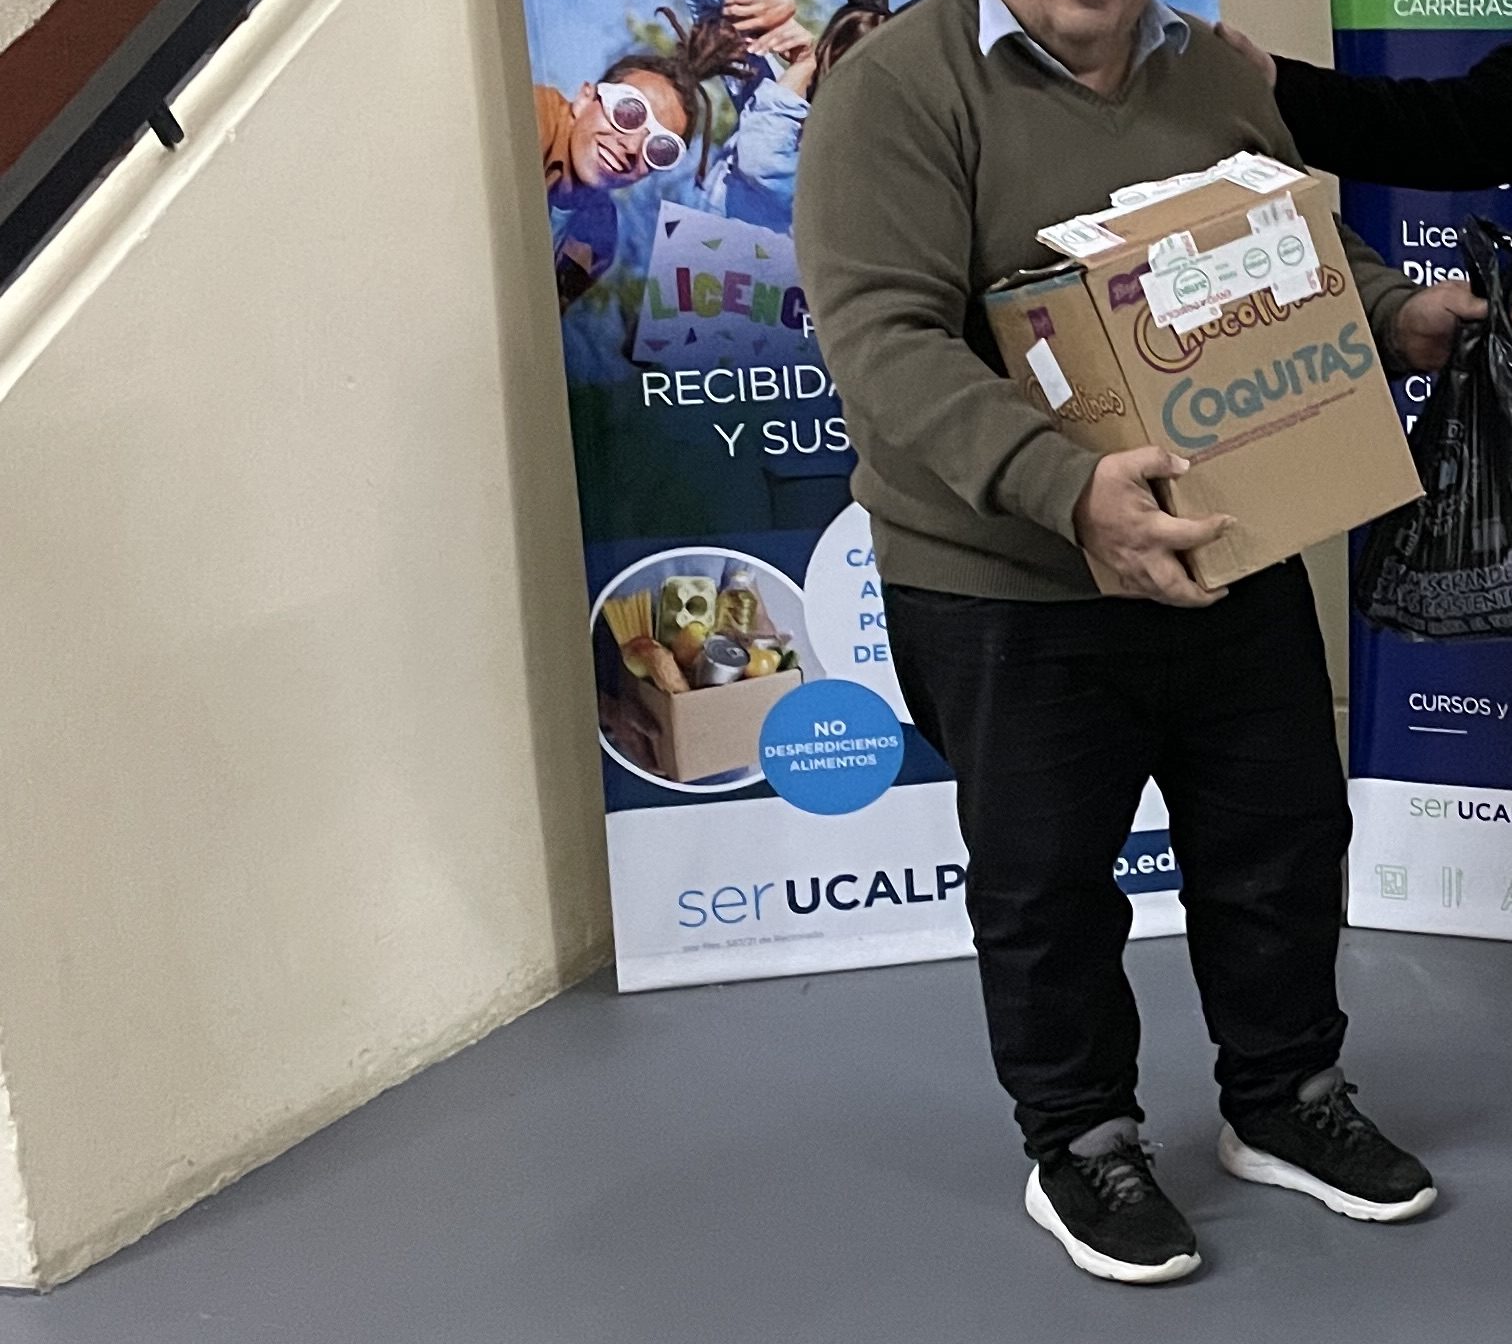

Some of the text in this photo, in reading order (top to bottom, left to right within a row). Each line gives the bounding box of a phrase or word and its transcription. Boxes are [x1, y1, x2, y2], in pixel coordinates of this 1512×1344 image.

[1162, 322, 1374, 449] COQUITAS
[713, 422, 745, 457] Y
[1408, 693, 1491, 716] CURSOS
[1497, 700, 1508, 719] y
[814, 720, 847, 738] NO
[764, 735, 899, 759] DESPERDICIEMOS
[789, 753, 878, 772] ALIMENTOS
[1410, 797, 1455, 819] ser
[678, 863, 967, 928] ser UCALP
